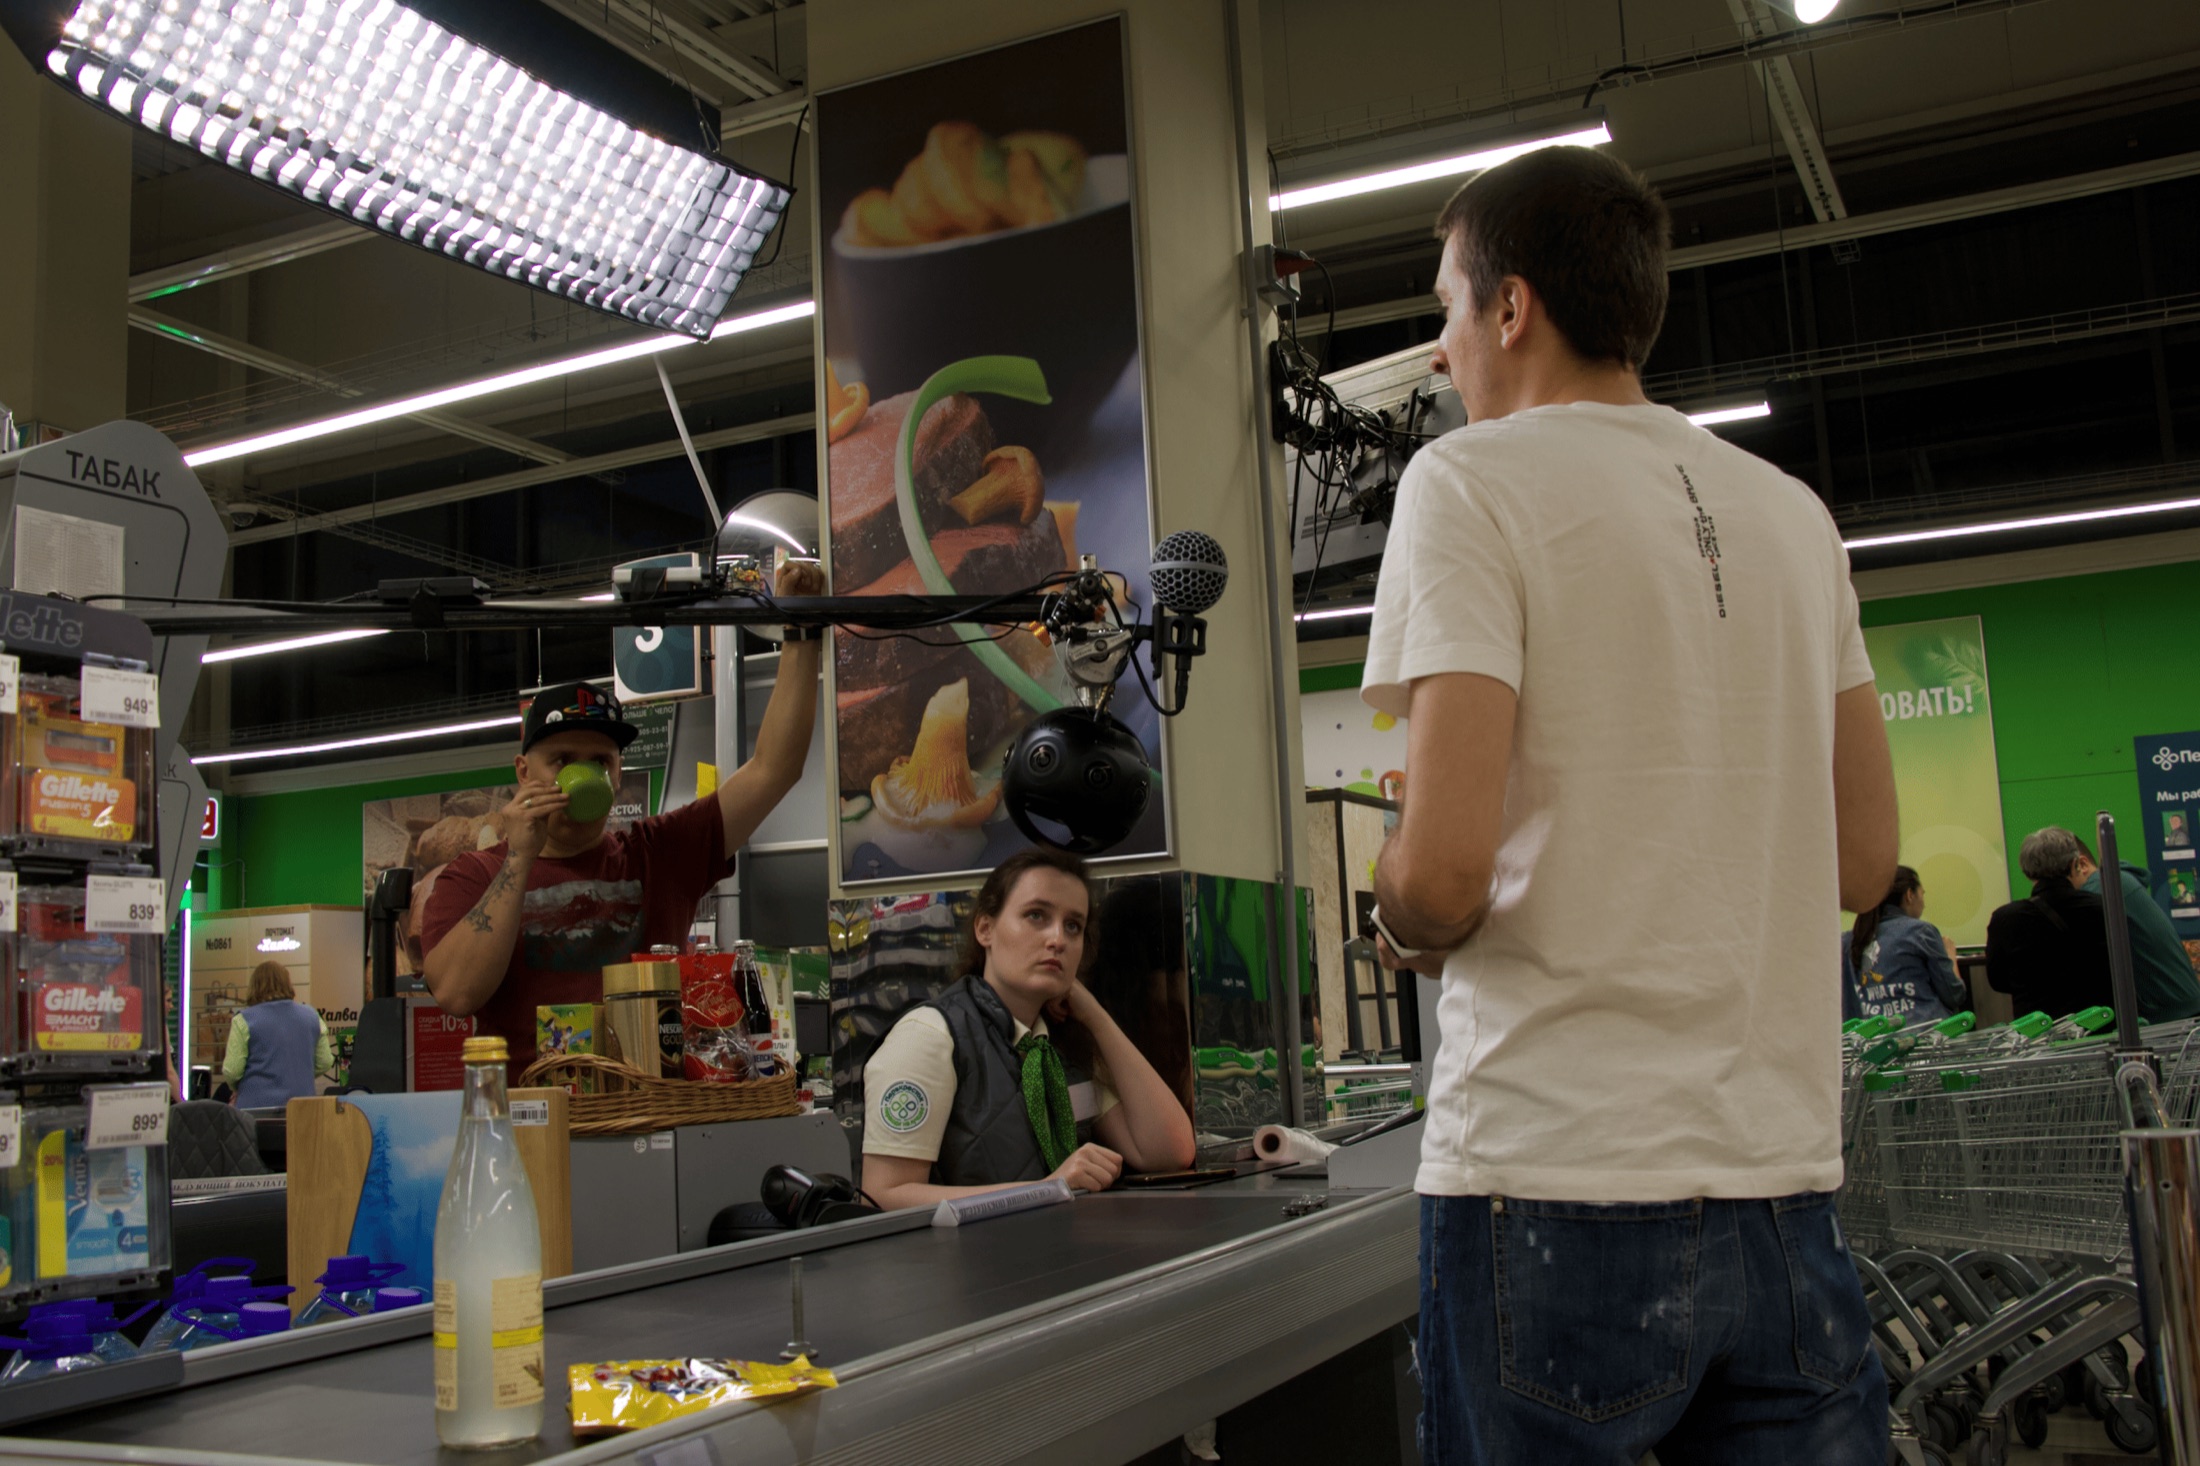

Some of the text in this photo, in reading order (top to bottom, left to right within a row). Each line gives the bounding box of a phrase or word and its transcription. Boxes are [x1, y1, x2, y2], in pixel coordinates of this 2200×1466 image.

[66, 450, 161, 498] ТАБАК
[1675, 463, 1698, 504] BRAVE
[1701, 526, 1715, 560] ONLY
[1712, 564, 1726, 618] DIESEL
[124, 697, 148, 713] 949
[1880, 685, 1974, 721] ОВАТЬ!
[40, 774, 120, 805] Gillette
[2156, 791, 2180, 802] Мы
[129, 903, 155, 920] 839
[206, 937, 232, 950] №0861
[44, 988, 126, 1014] Gillette
[1866, 982, 1916, 1002] WHAT'S
[440, 1014, 469, 1032] 10%
[132, 1113, 158, 1131] 899
[68, 1153, 88, 1217] Venus
[121, 1232, 132, 1247] 4
